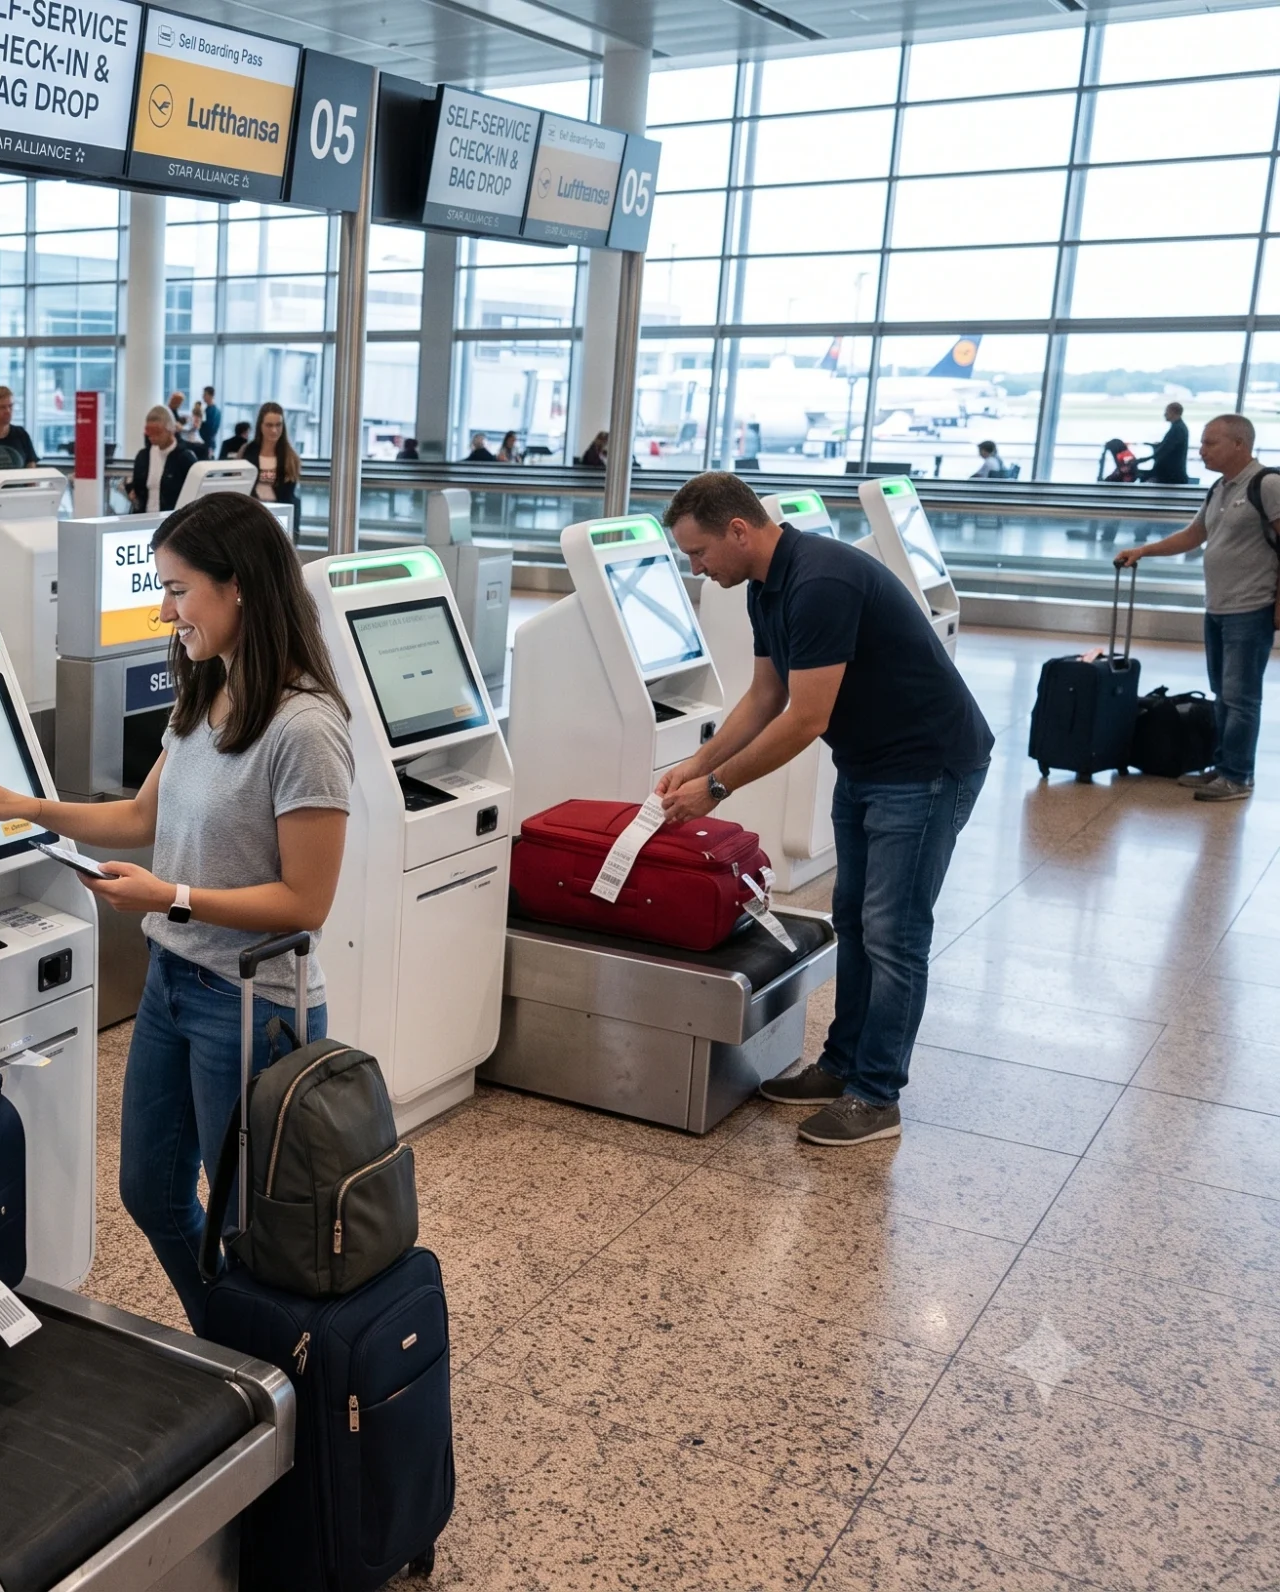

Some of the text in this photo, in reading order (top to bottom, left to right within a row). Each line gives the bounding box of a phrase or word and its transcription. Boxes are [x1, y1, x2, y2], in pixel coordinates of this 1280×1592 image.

[179, 33, 263, 67] Sell Boarding Pass
[94, 54, 110, 83] &
[34, 82, 100, 119] DROP
[187, 97, 280, 144] Lufthansa
[309, 98, 358, 165] 05
[14, 139, 72, 161] ALLIANCE
[449, 136, 519, 170] CHECK-IN &
[168, 163, 240, 187] STAR ALLIANCE
[449, 166, 511, 196] BAG DROP
[622, 168, 652, 217] 05
